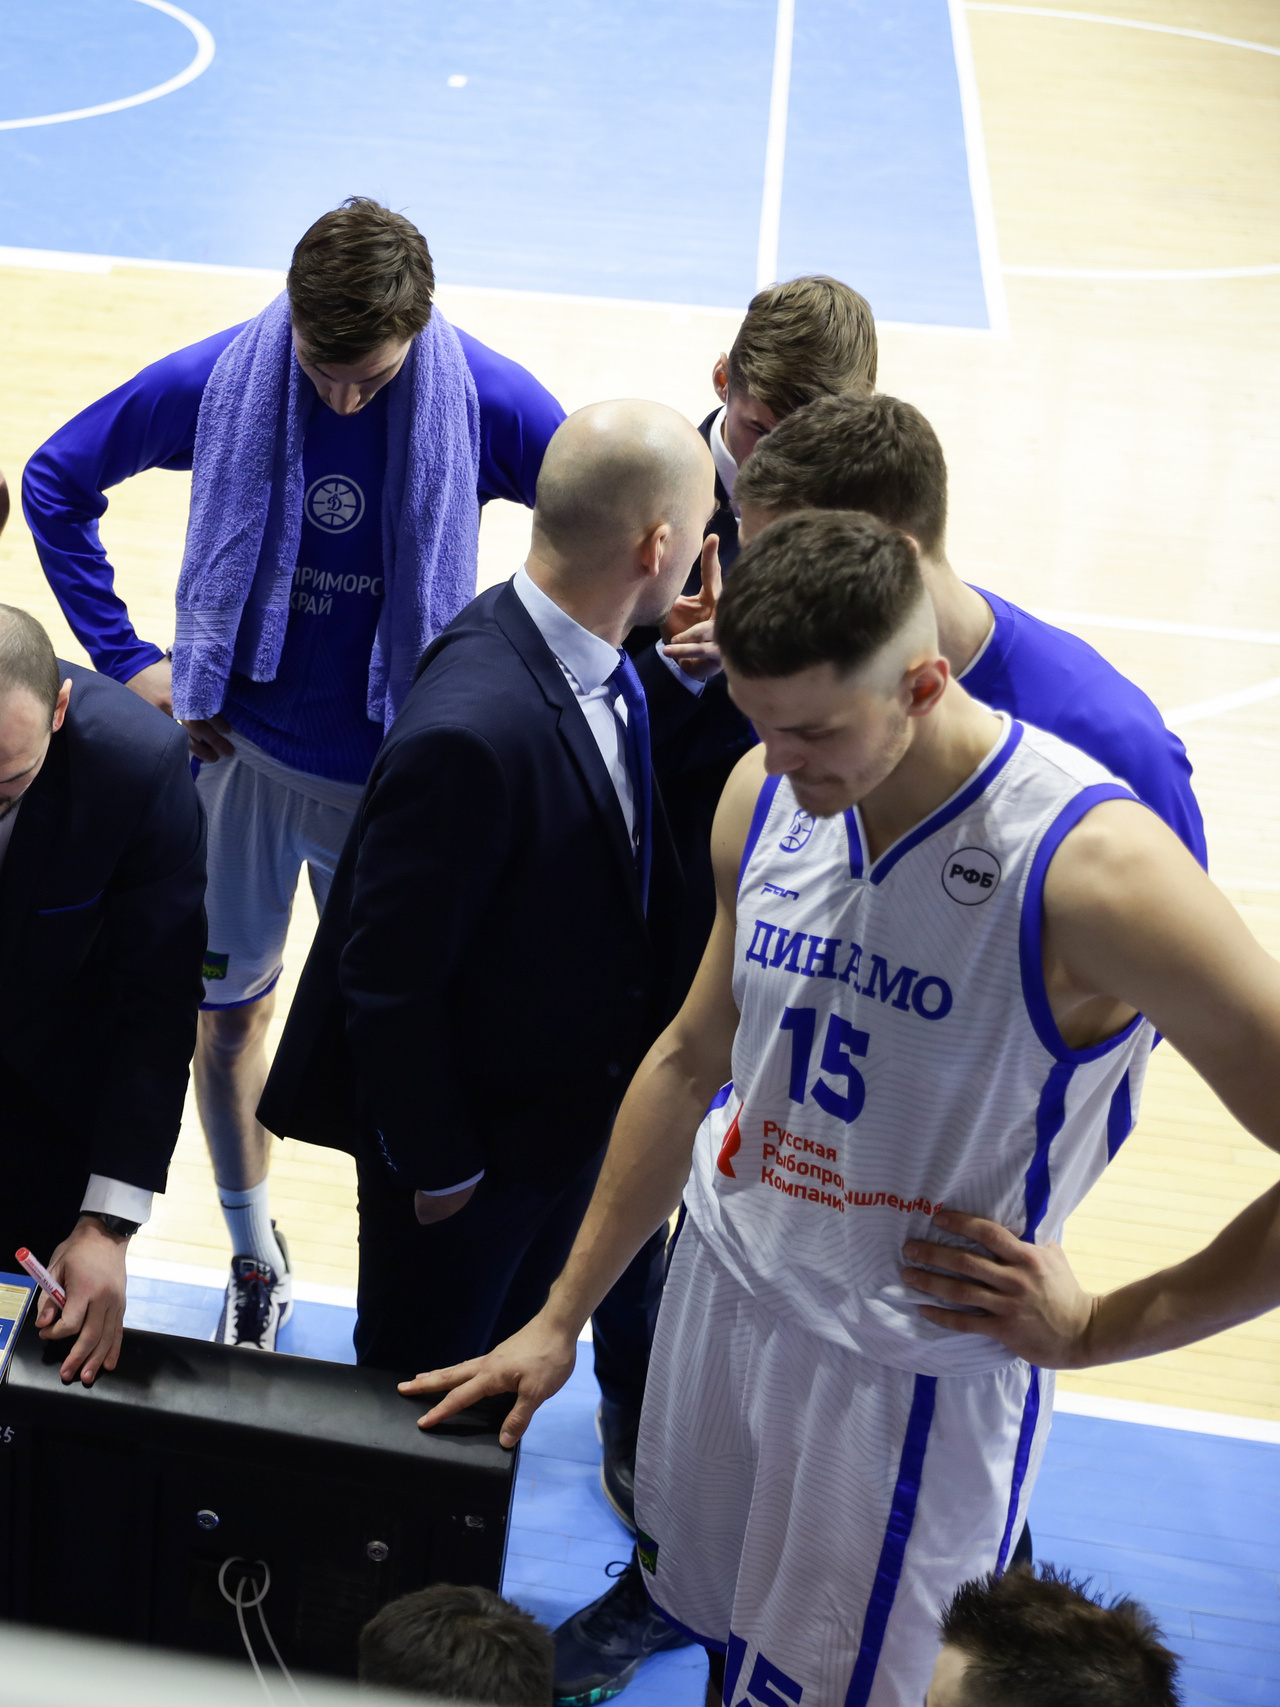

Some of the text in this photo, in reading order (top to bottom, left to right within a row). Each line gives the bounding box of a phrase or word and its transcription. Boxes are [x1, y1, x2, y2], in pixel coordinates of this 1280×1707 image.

[949, 863, 996, 889] РФБ
[746, 919, 953, 1021] ДИНАМО
[779, 1006, 870, 1125] 15
[763, 1120, 837, 1163] Русская
